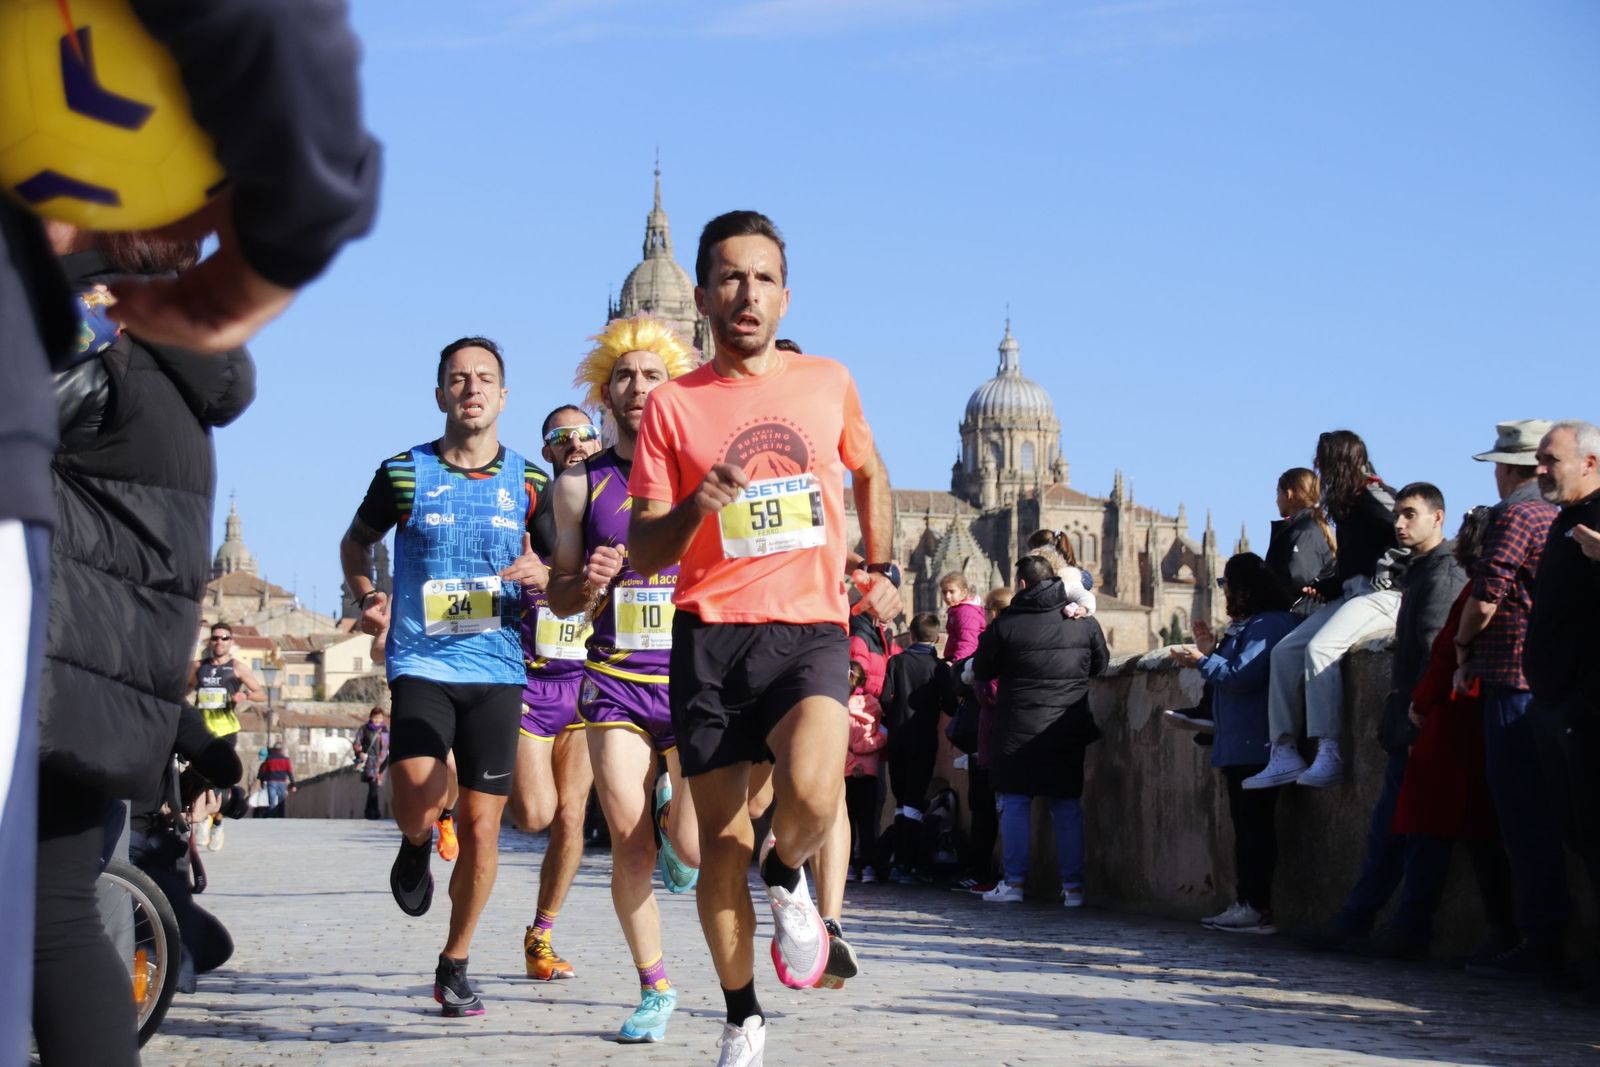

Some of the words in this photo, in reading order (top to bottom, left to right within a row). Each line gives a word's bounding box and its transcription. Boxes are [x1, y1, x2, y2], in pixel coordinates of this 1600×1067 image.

[737, 432, 790, 450] RUNNING
[740, 443, 792, 460] WALKING
[745, 478, 810, 499] SETEL
[750, 499, 782, 530] 59
[445, 582, 493, 591] SETEL
[636, 591, 674, 602] SET
[448, 594, 472, 615] 34
[642, 605, 662, 628] 10
[560, 623, 576, 643] 19
